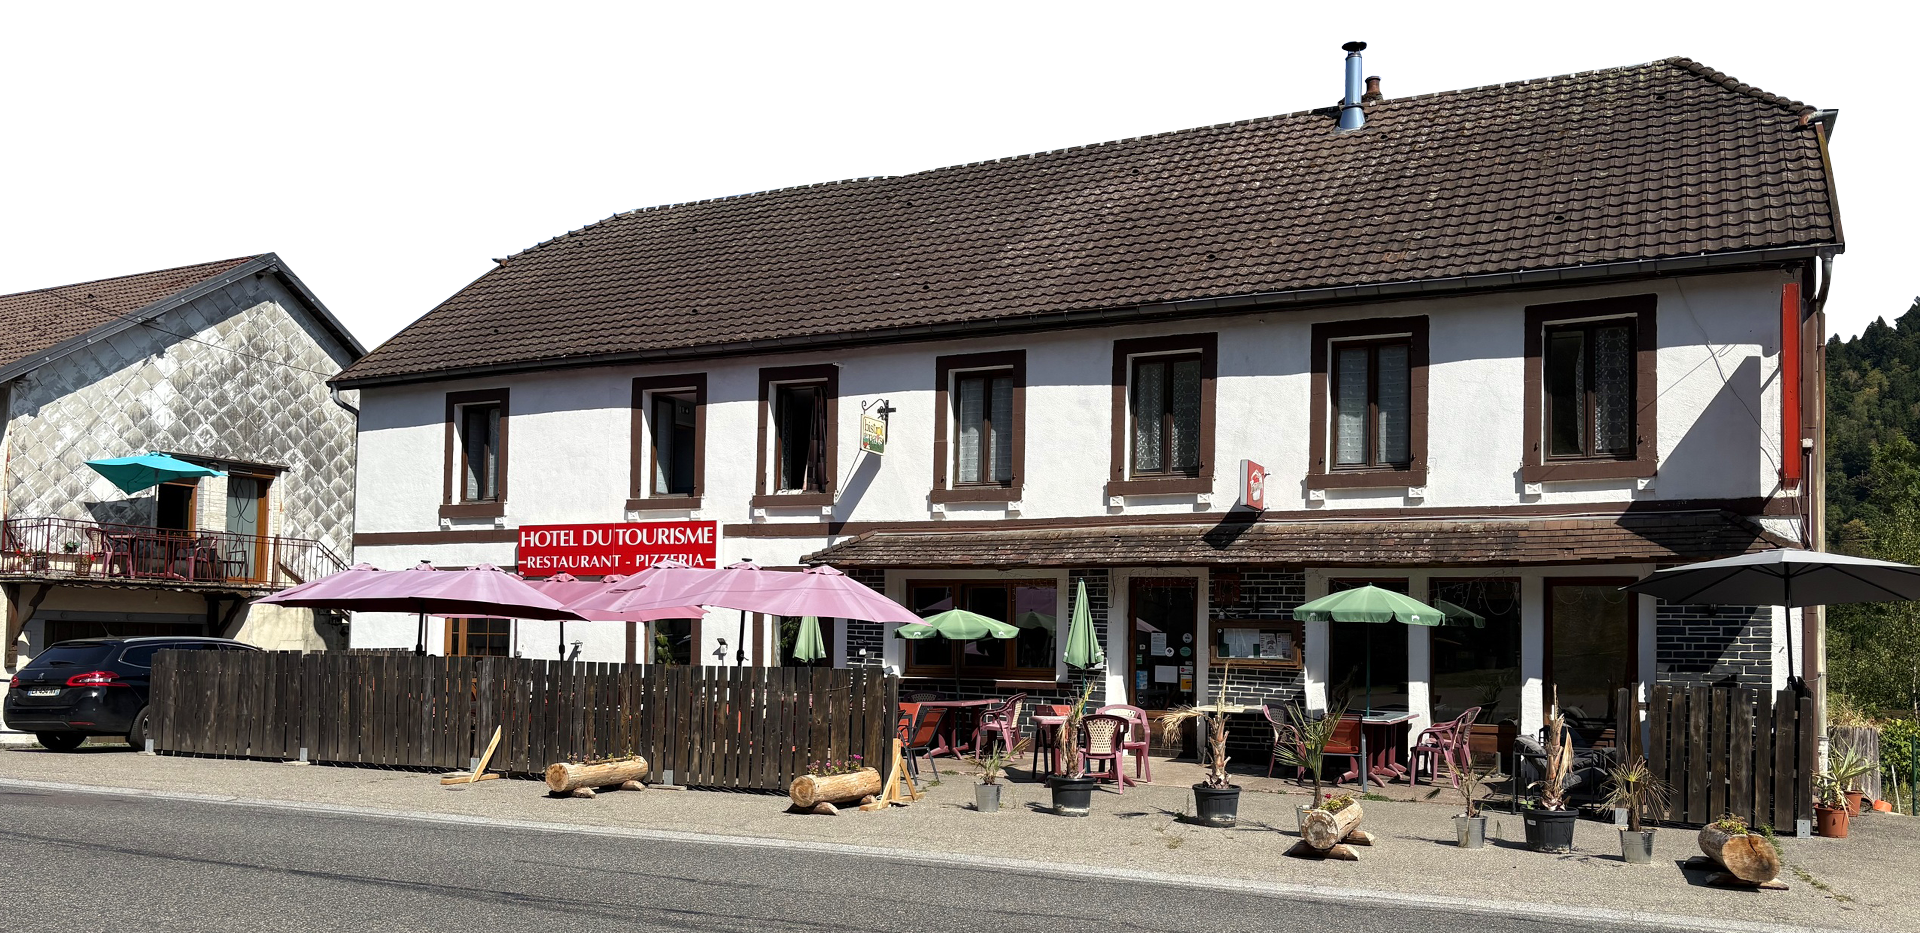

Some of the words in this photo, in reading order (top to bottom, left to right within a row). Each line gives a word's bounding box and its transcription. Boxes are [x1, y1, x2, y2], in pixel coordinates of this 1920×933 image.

[521, 530, 578, 547] HOTEL
[583, 529, 612, 546] DU
[615, 527, 713, 546] TOURISME
[527, 554, 621, 568] RESTAURANT
